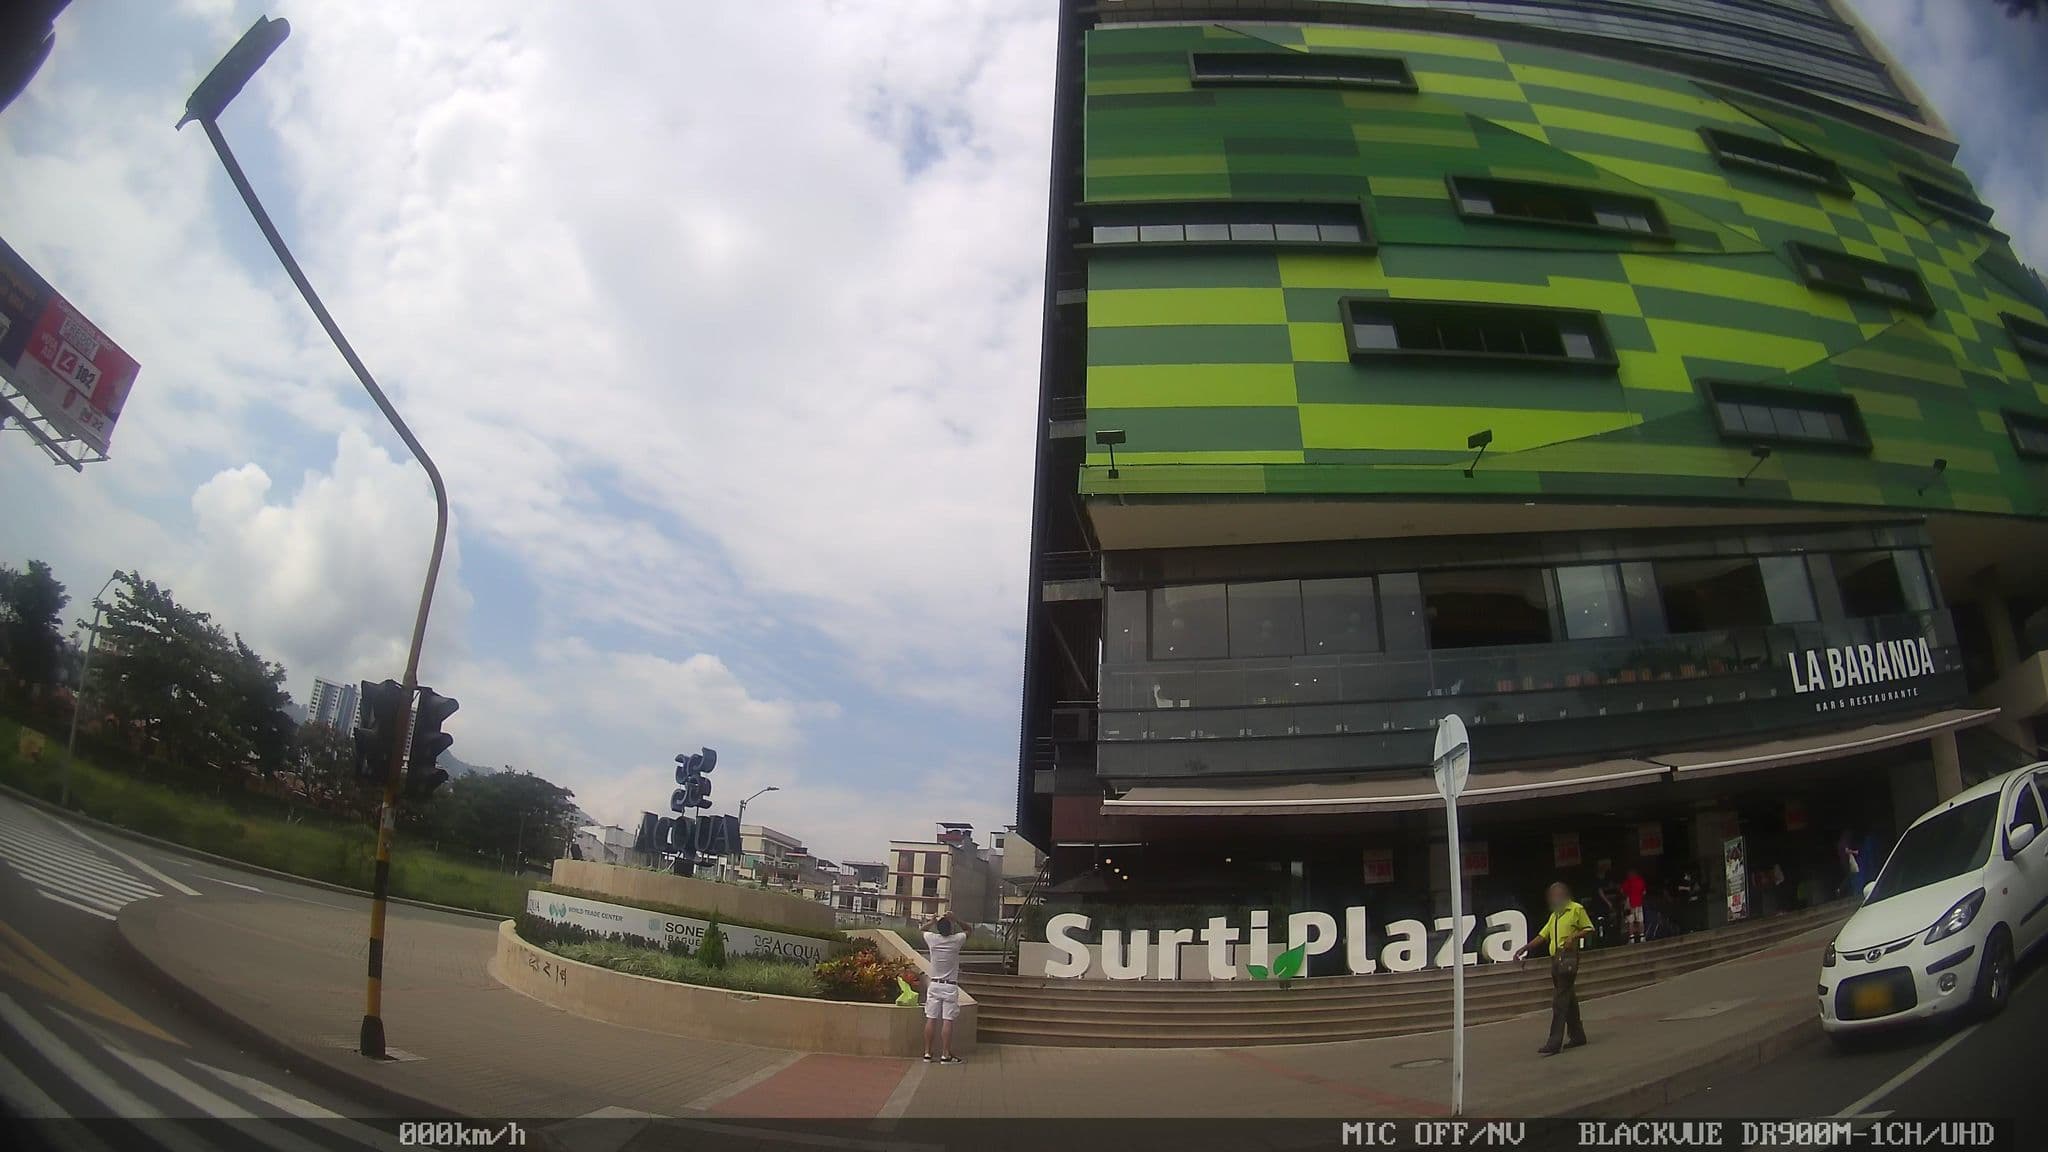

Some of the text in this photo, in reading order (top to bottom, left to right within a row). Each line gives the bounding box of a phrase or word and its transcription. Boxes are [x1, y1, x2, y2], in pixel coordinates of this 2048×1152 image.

[1788, 637, 1935, 693] LA BARANDA
[1816, 700, 1836, 712] BAR
[1849, 687, 1919, 706] RESTAURANTE
[634, 811, 743, 860] ACQUA
[584, 908, 601, 918] TRADE
[601, 912, 624, 922] CENTER
[665, 922, 730, 943] SONEA
[772, 939, 821, 964] ACQUA
